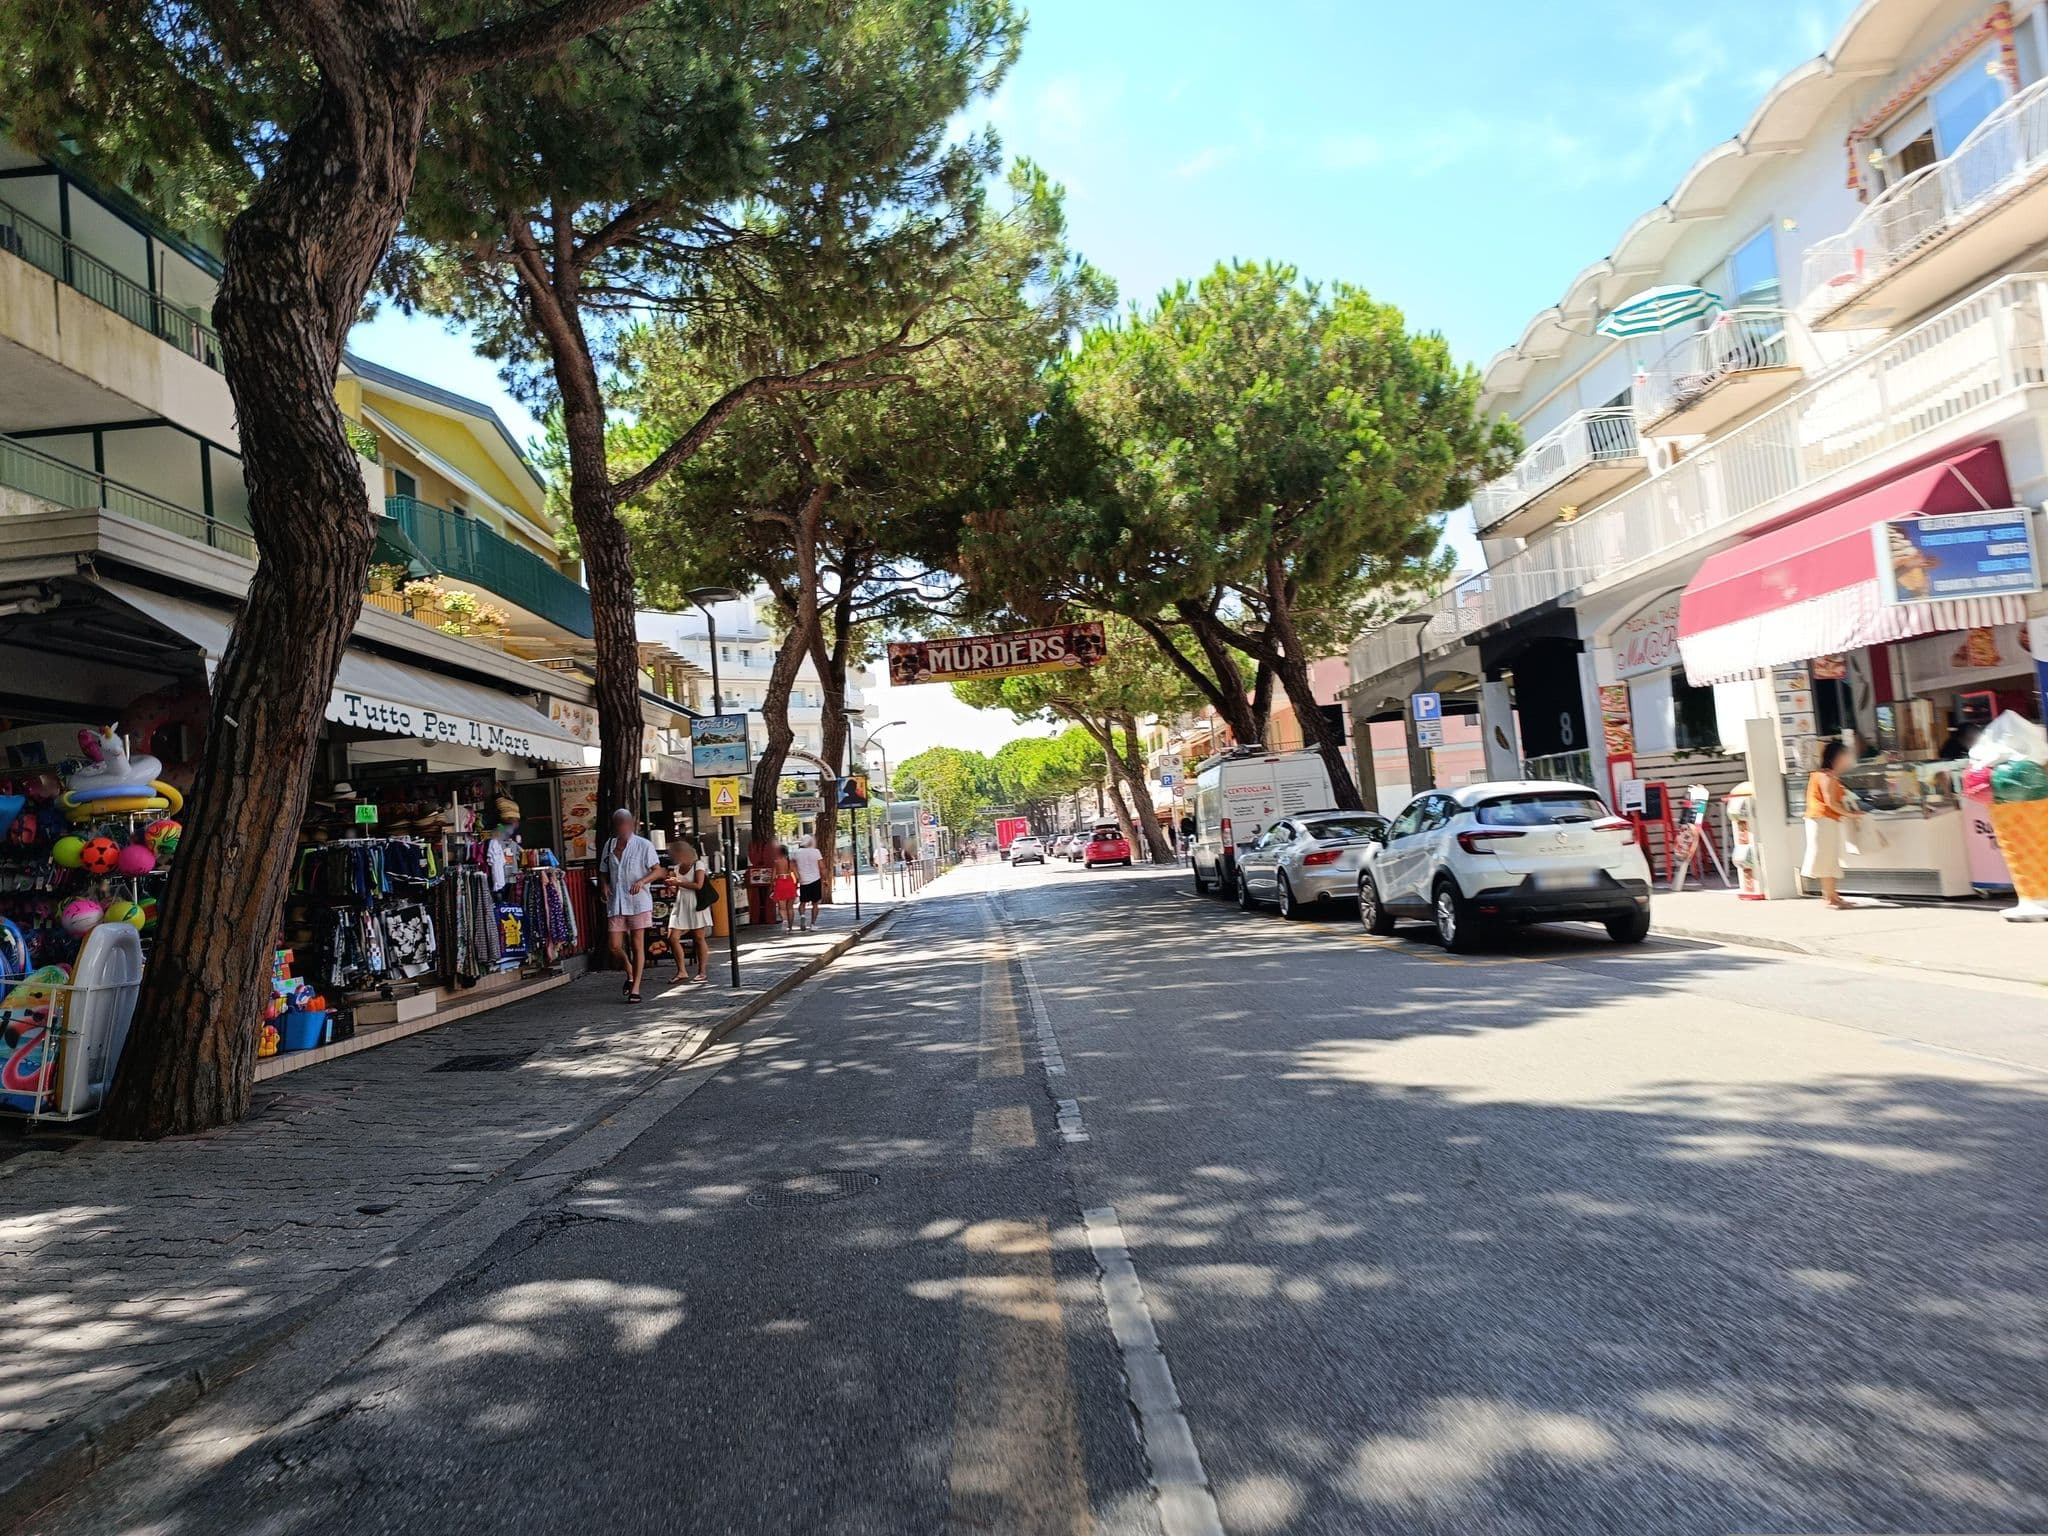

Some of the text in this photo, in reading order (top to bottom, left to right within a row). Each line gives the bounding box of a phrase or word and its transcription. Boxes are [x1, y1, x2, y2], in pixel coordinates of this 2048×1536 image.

[928, 635, 1066, 673] MURDERS
[344, 693, 530, 751] Tutto Per Il Mare
[1417, 696, 1436, 718] P
[1560, 711, 1574, 746] 8
[1163, 776, 1171, 785] P
